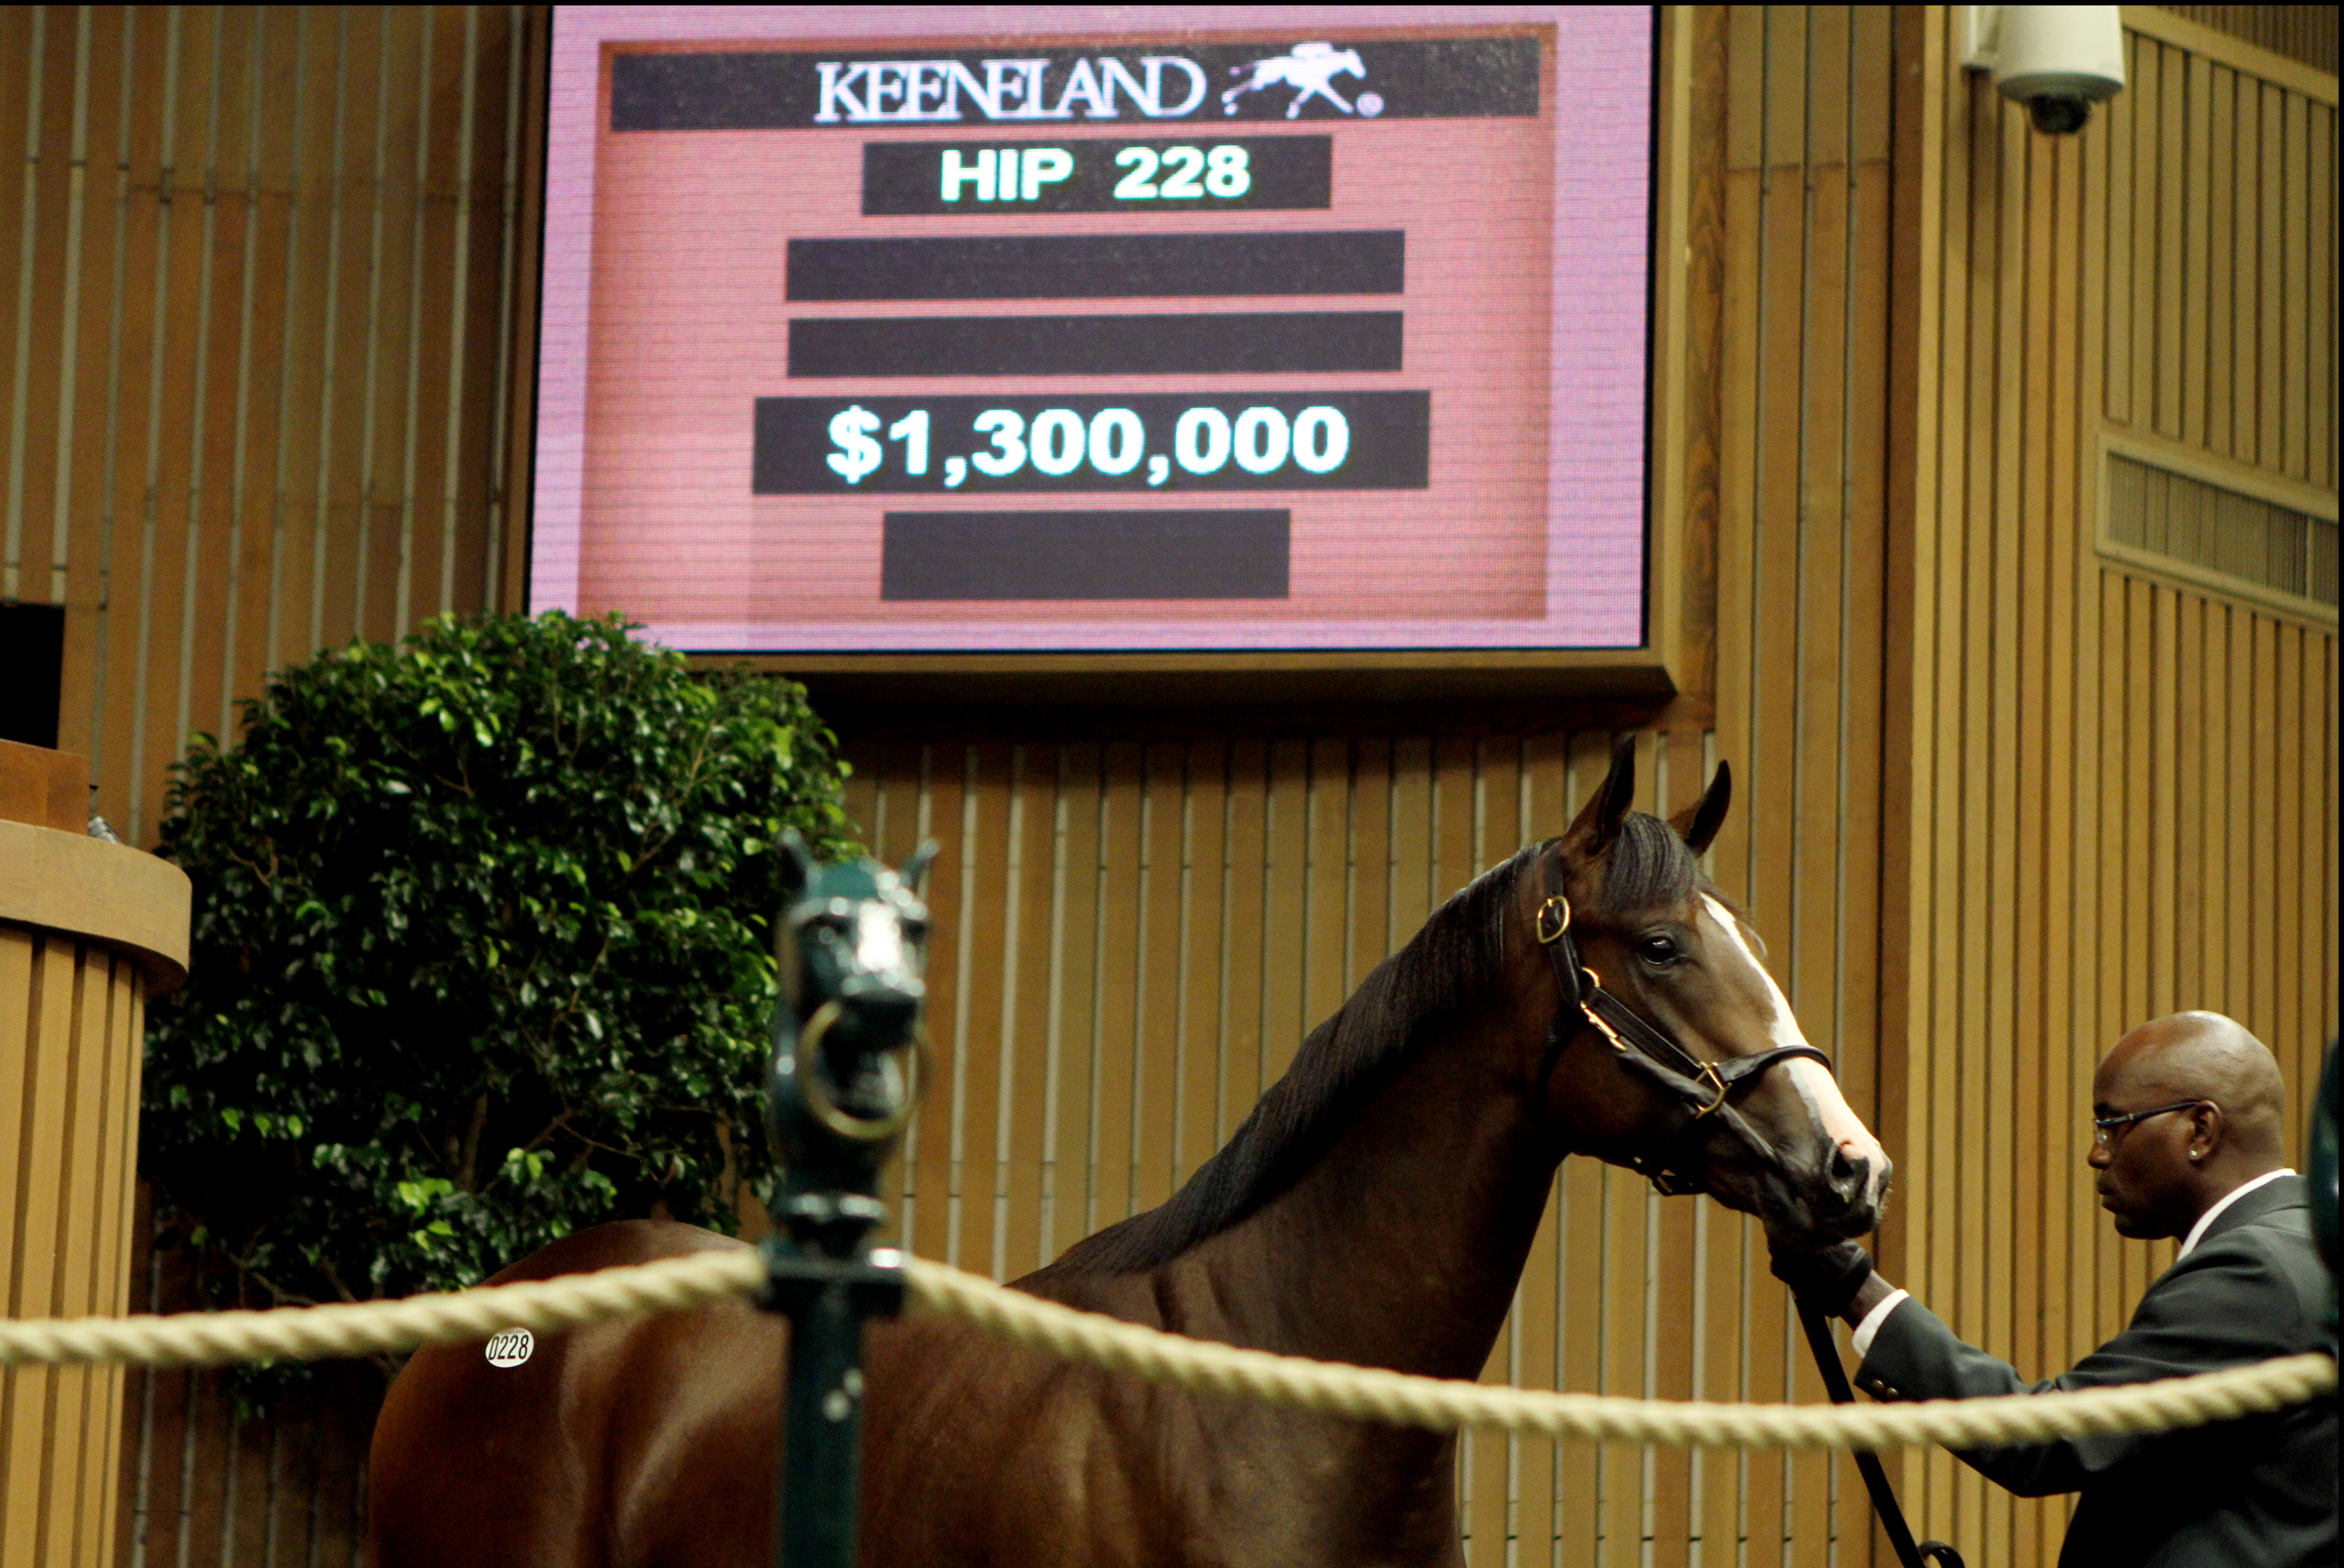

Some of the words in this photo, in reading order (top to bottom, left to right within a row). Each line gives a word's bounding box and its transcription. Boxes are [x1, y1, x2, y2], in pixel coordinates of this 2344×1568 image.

[814, 56, 1207, 123] KEENELAND
[940, 147, 1075, 202] HIP
[1113, 145, 1252, 200] 228
[826, 404, 1350, 487] $1,300,000
[488, 1334, 529, 1360] 0228
